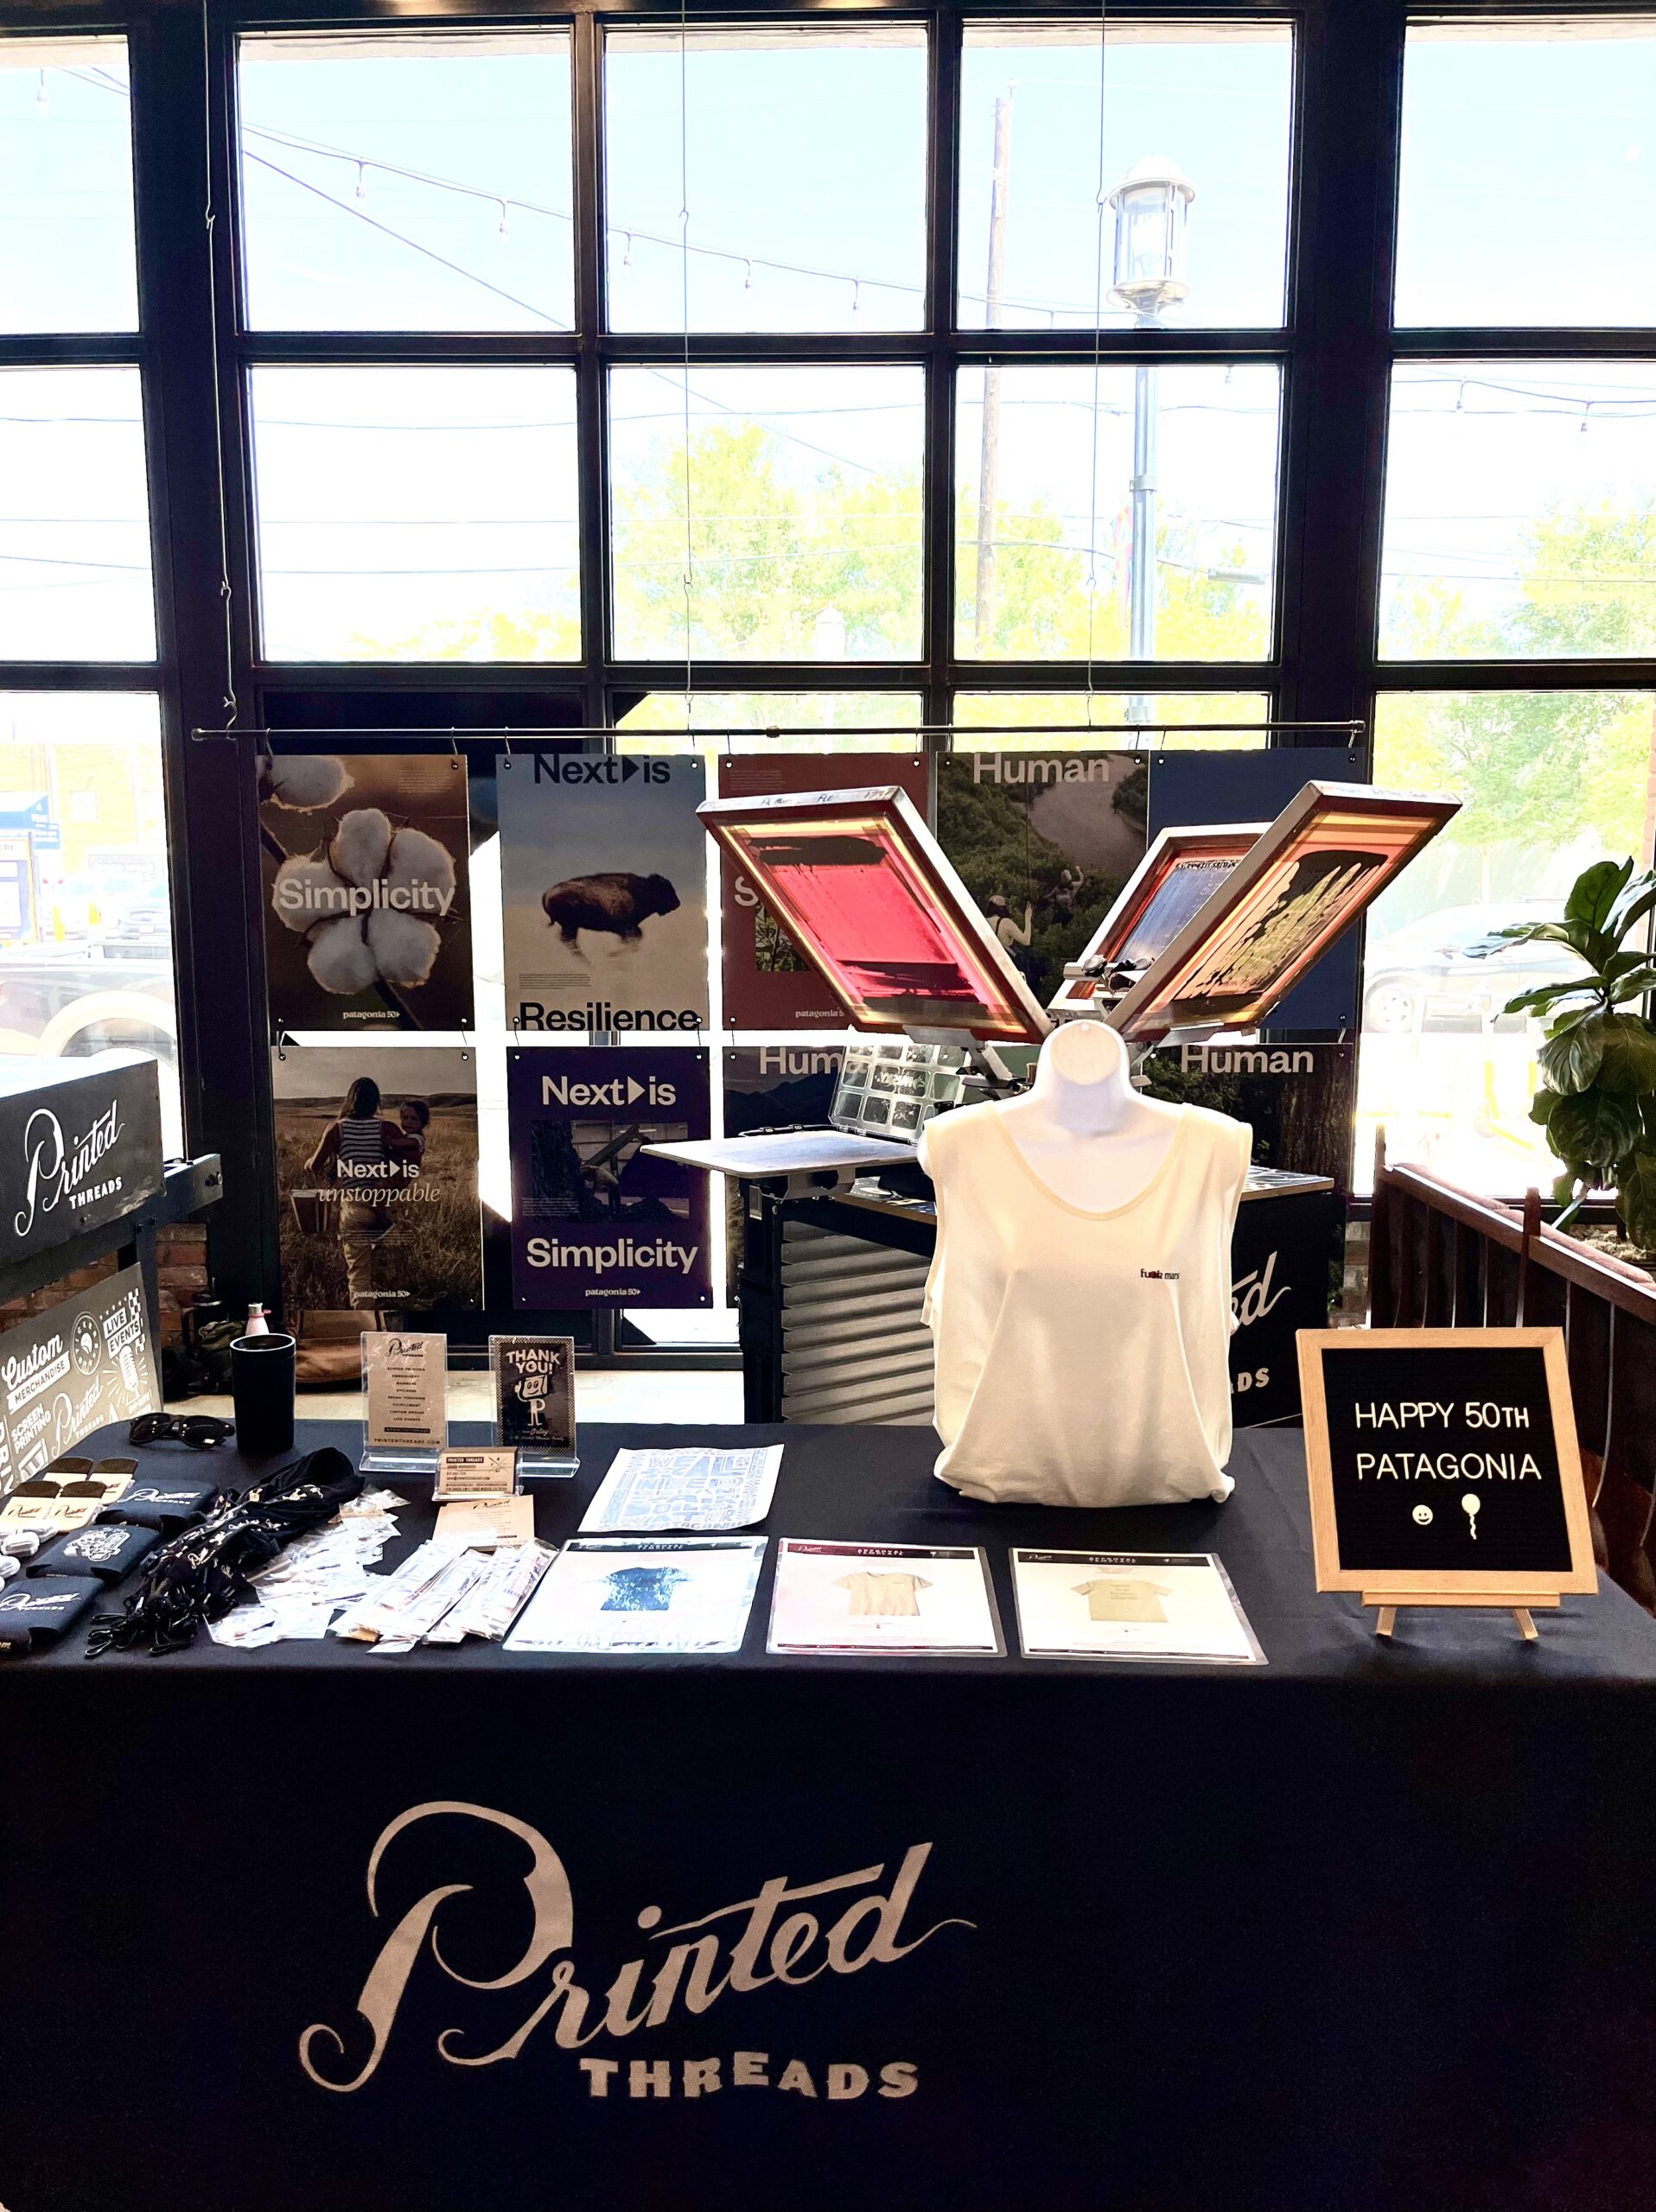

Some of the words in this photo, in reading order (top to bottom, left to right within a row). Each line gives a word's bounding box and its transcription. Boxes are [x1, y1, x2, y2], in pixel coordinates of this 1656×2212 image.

[534, 754, 619, 784] Next
[643, 754, 671, 784] is
[972, 753, 1110, 784] Human
[278, 878, 455, 916] Simplicity
[343, 1011, 385, 1020] patagonia
[519, 1001, 698, 1030] Resilience
[795, 1009, 838, 1019] patagonia
[1181, 1046, 1314, 1073] Human
[543, 1076, 624, 1106] Next
[649, 1075, 676, 1106] is
[15, 1099, 125, 1237] Printed
[336, 1159, 388, 1179] Next
[402, 1159, 420, 1179] is
[69, 1175, 124, 1211] THREADS
[319, 1182, 440, 1208] unstoppable
[527, 1237, 699, 1274] Simplicity
[353, 1290, 397, 1300] patagonia
[584, 1288, 627, 1298] patagonia
[105, 1313, 125, 1335] LIVE
[110, 1322, 141, 1353] EVENTS
[2, 1333, 65, 1391] Custom
[506, 1349, 562, 1365] THANK
[515, 1361, 554, 1376] YOU!
[14, 1360, 67, 1402] MERCHANDISE
[11, 1402, 45, 1440] SCREEN
[52, 1375, 105, 1459] Printed
[1354, 1402, 1455, 1430] HAPPY
[1465, 1402, 1530, 1430] 50TH
[14, 1410, 52, 1455] PRINTING
[1356, 1452, 1543, 1481] PATAGONIA
[298, 1800, 978, 2093] Printed
[579, 2050, 920, 2101] THREADS
